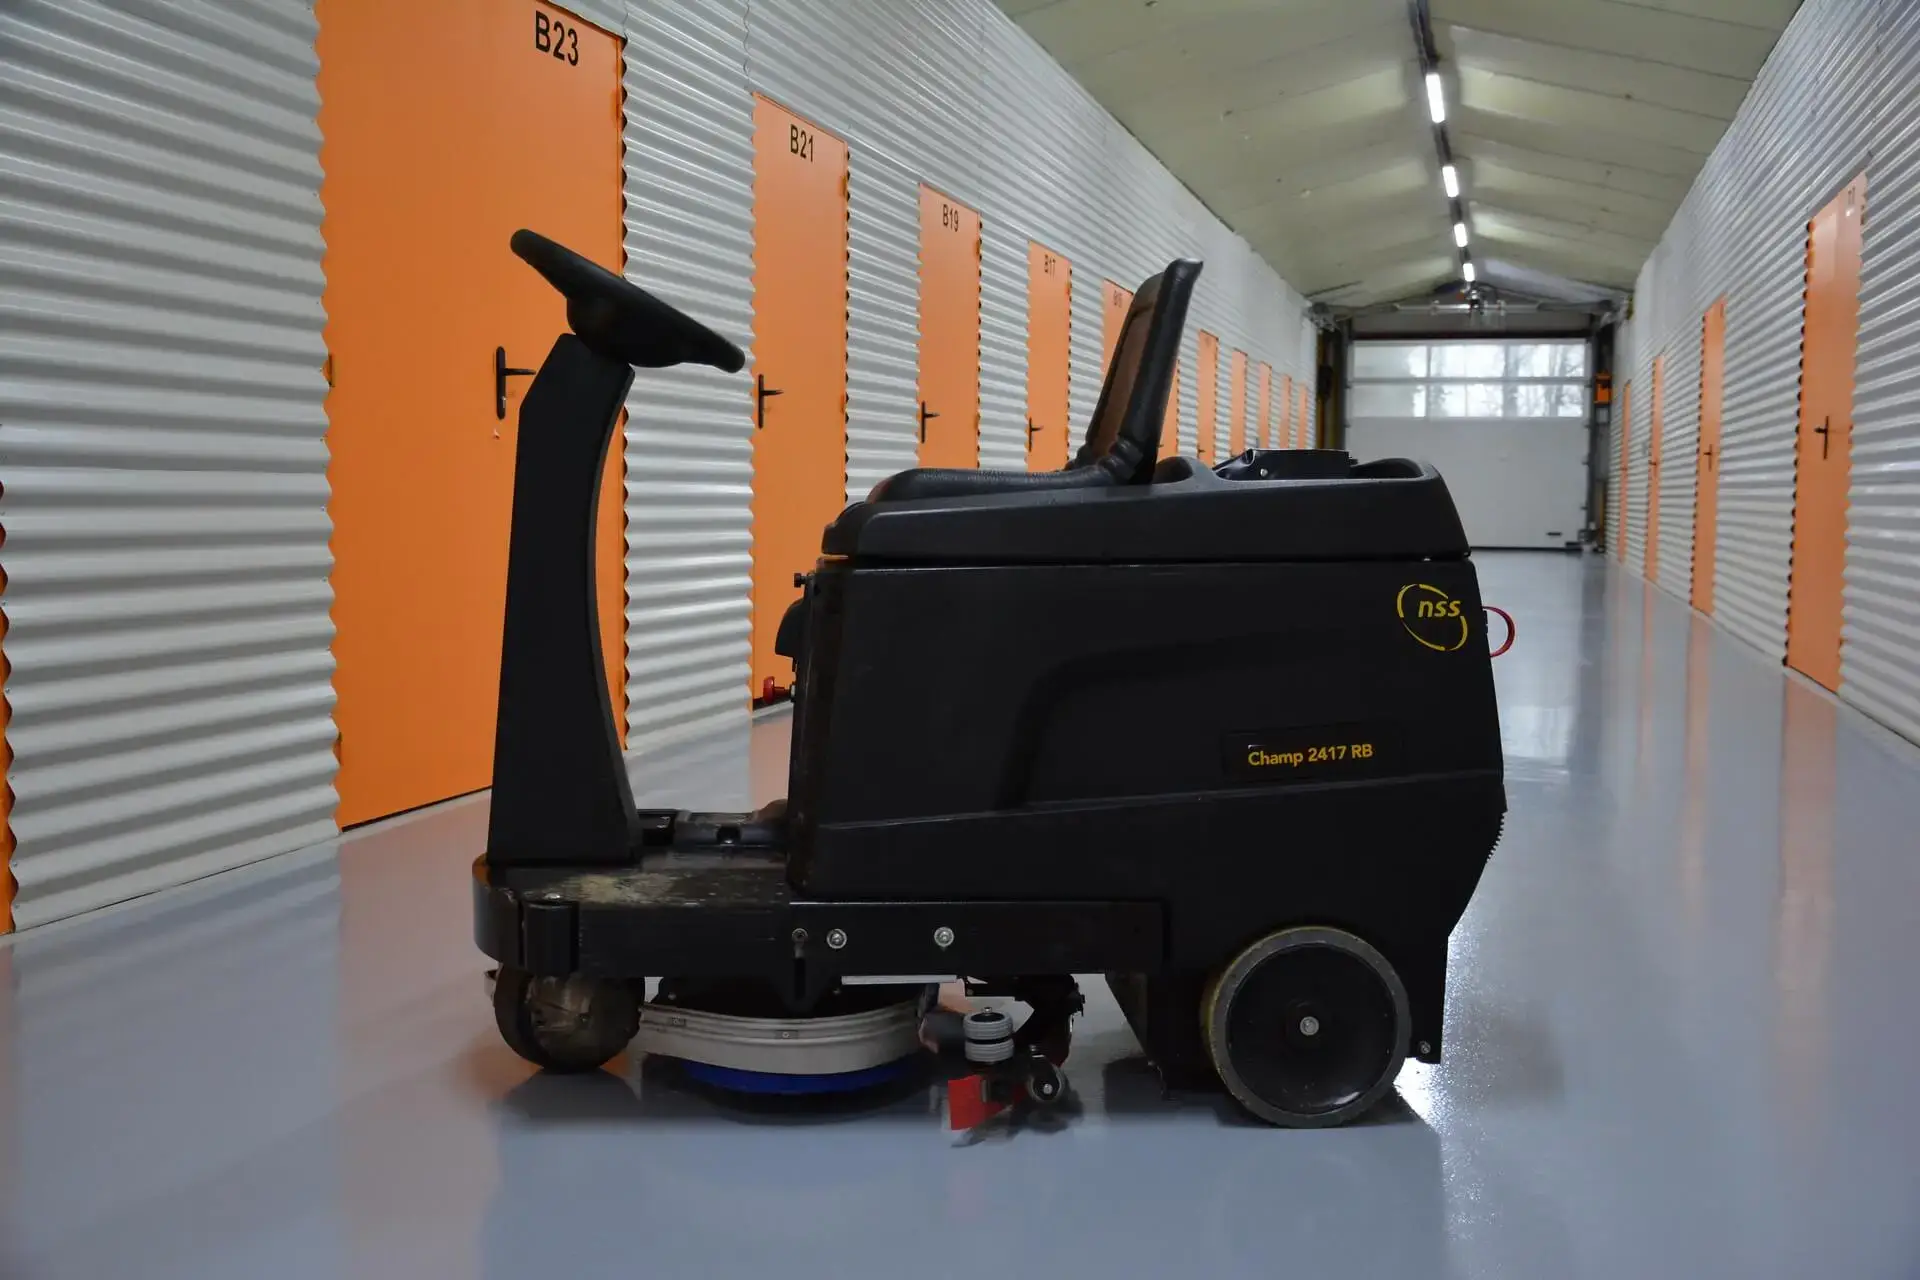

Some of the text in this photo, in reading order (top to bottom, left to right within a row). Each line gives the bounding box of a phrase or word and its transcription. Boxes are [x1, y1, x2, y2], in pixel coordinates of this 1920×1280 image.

[535, 10, 579, 67] B23
[790, 124, 814, 163] B21
[943, 203, 959, 233] B19
[1418, 599, 1461, 618] nss
[1248, 743, 1374, 767] Champ 2417 RB
